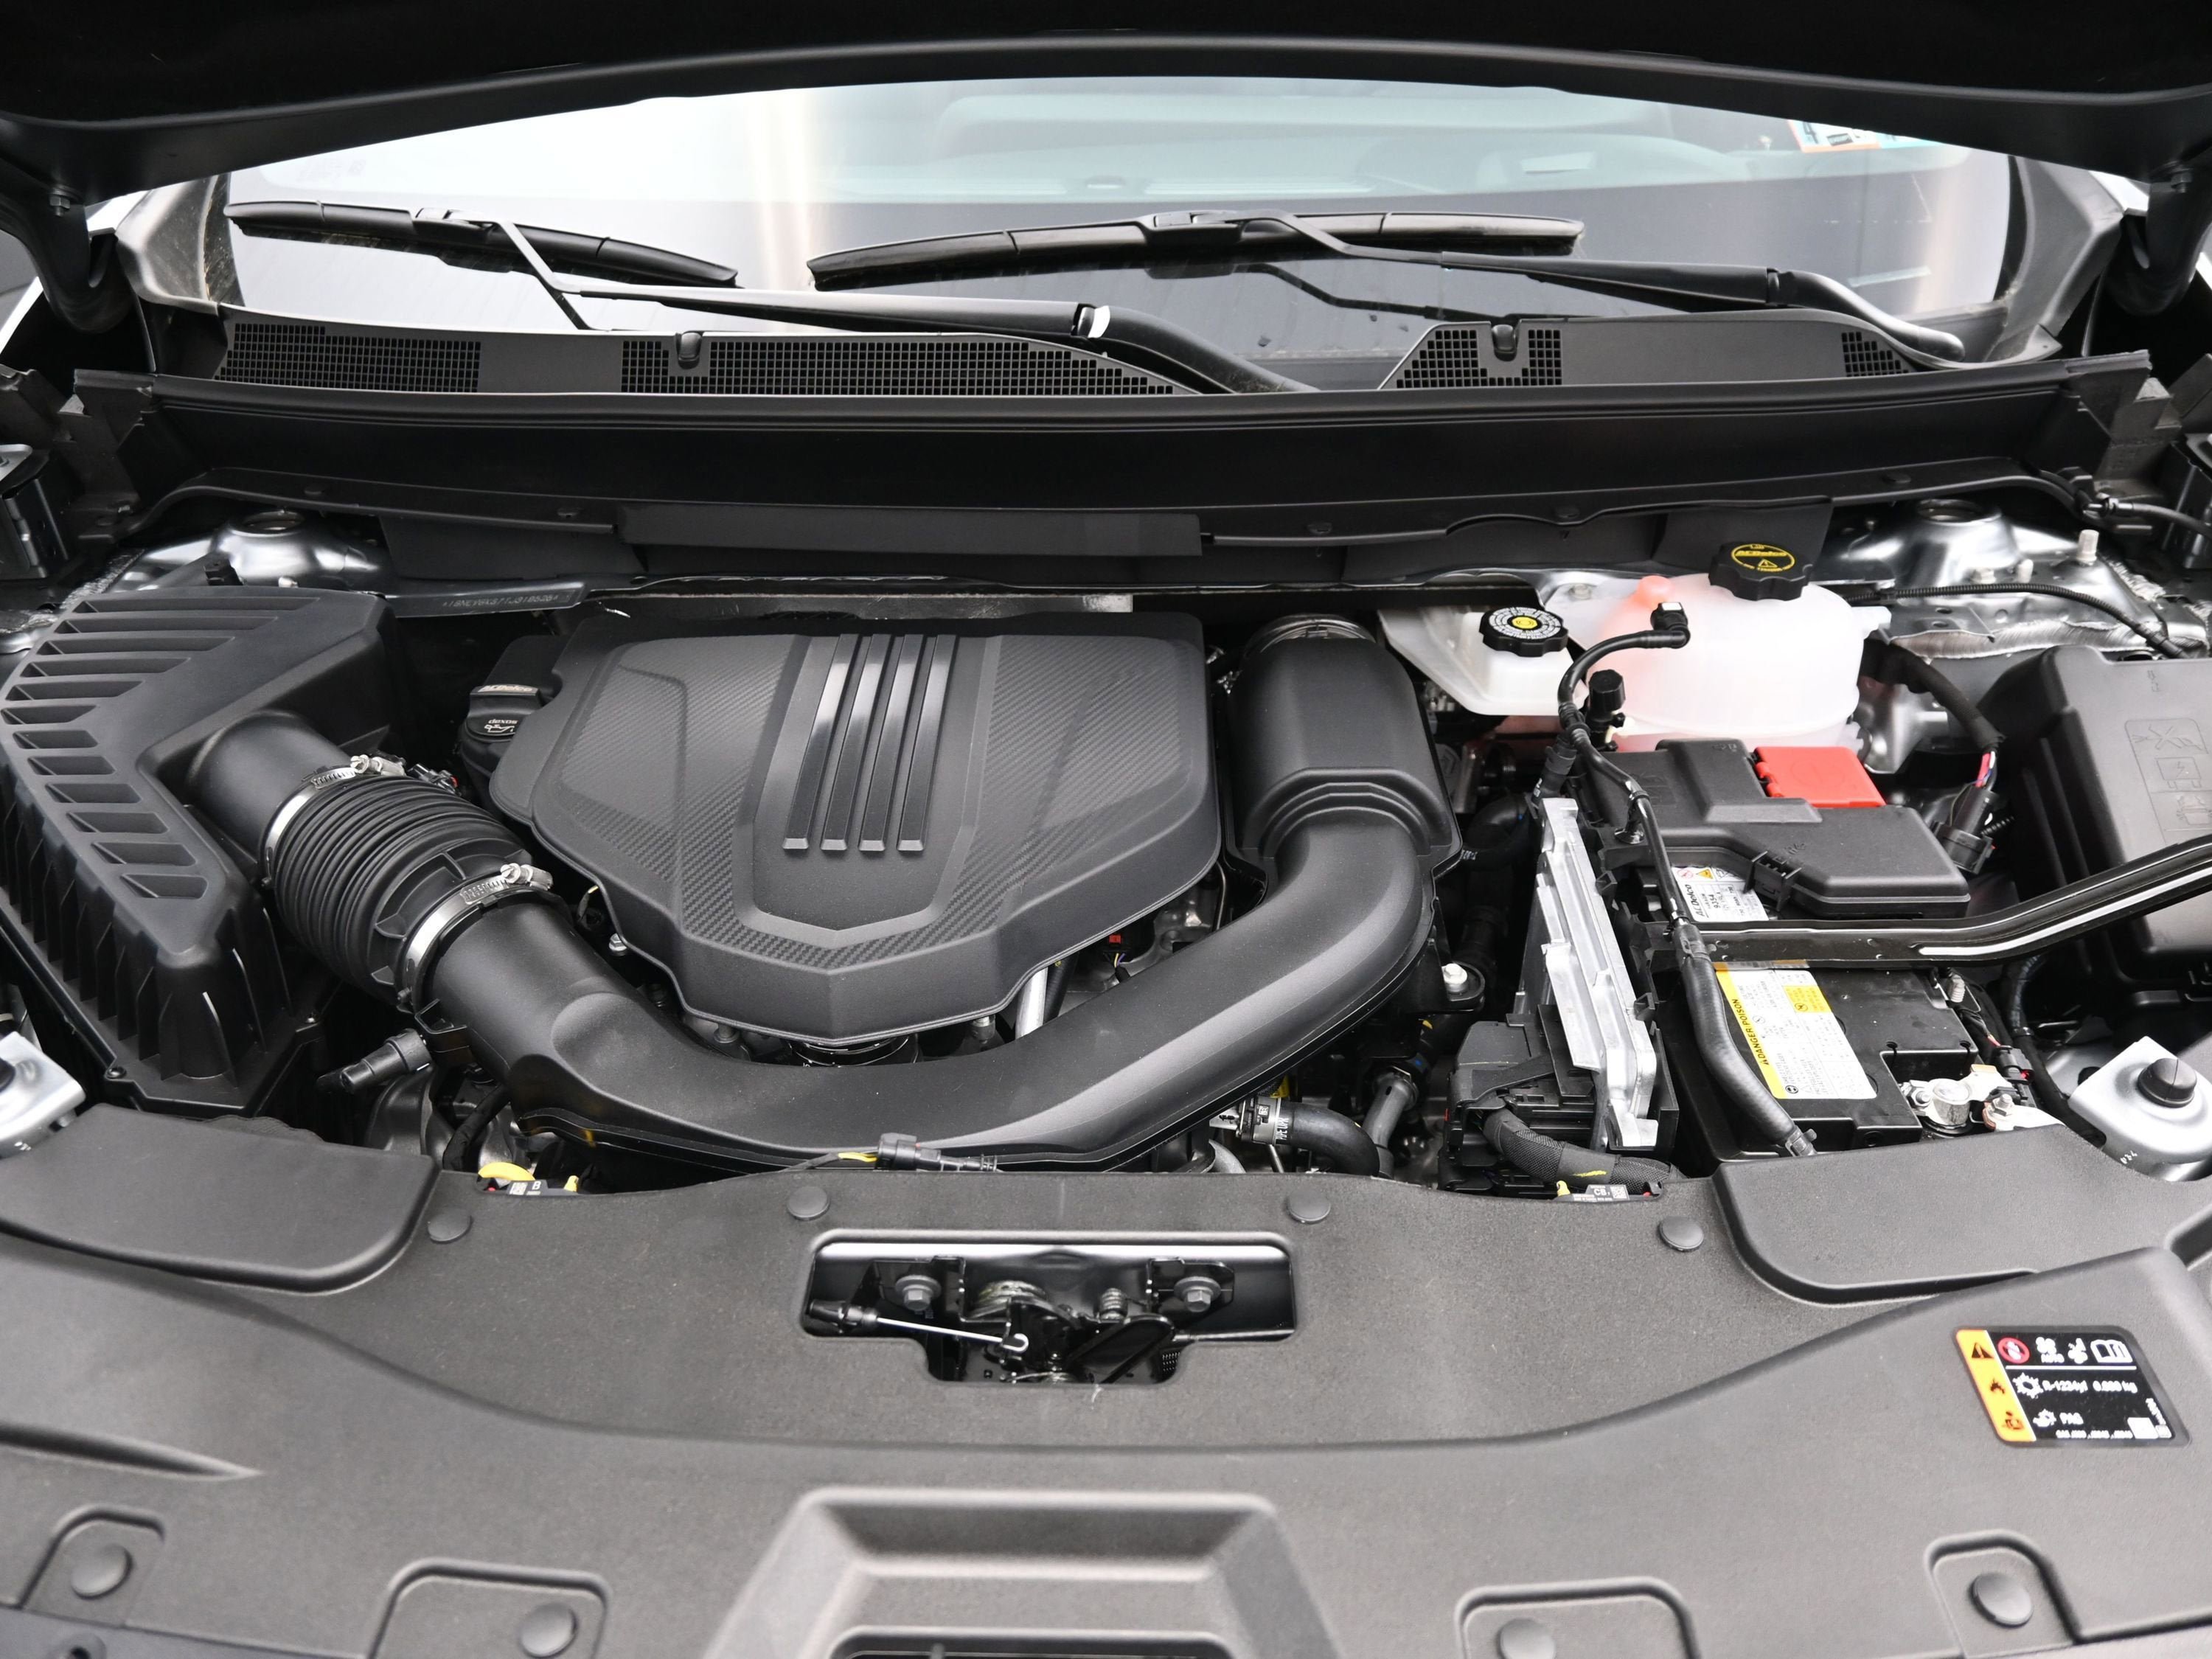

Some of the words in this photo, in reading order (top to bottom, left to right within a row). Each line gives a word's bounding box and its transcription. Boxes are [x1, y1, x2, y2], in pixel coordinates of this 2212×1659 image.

[1685, 884, 1705, 917] ACDelco
[1731, 998, 1750, 1026] POISON
[1745, 1027, 1767, 1059] DANGER
